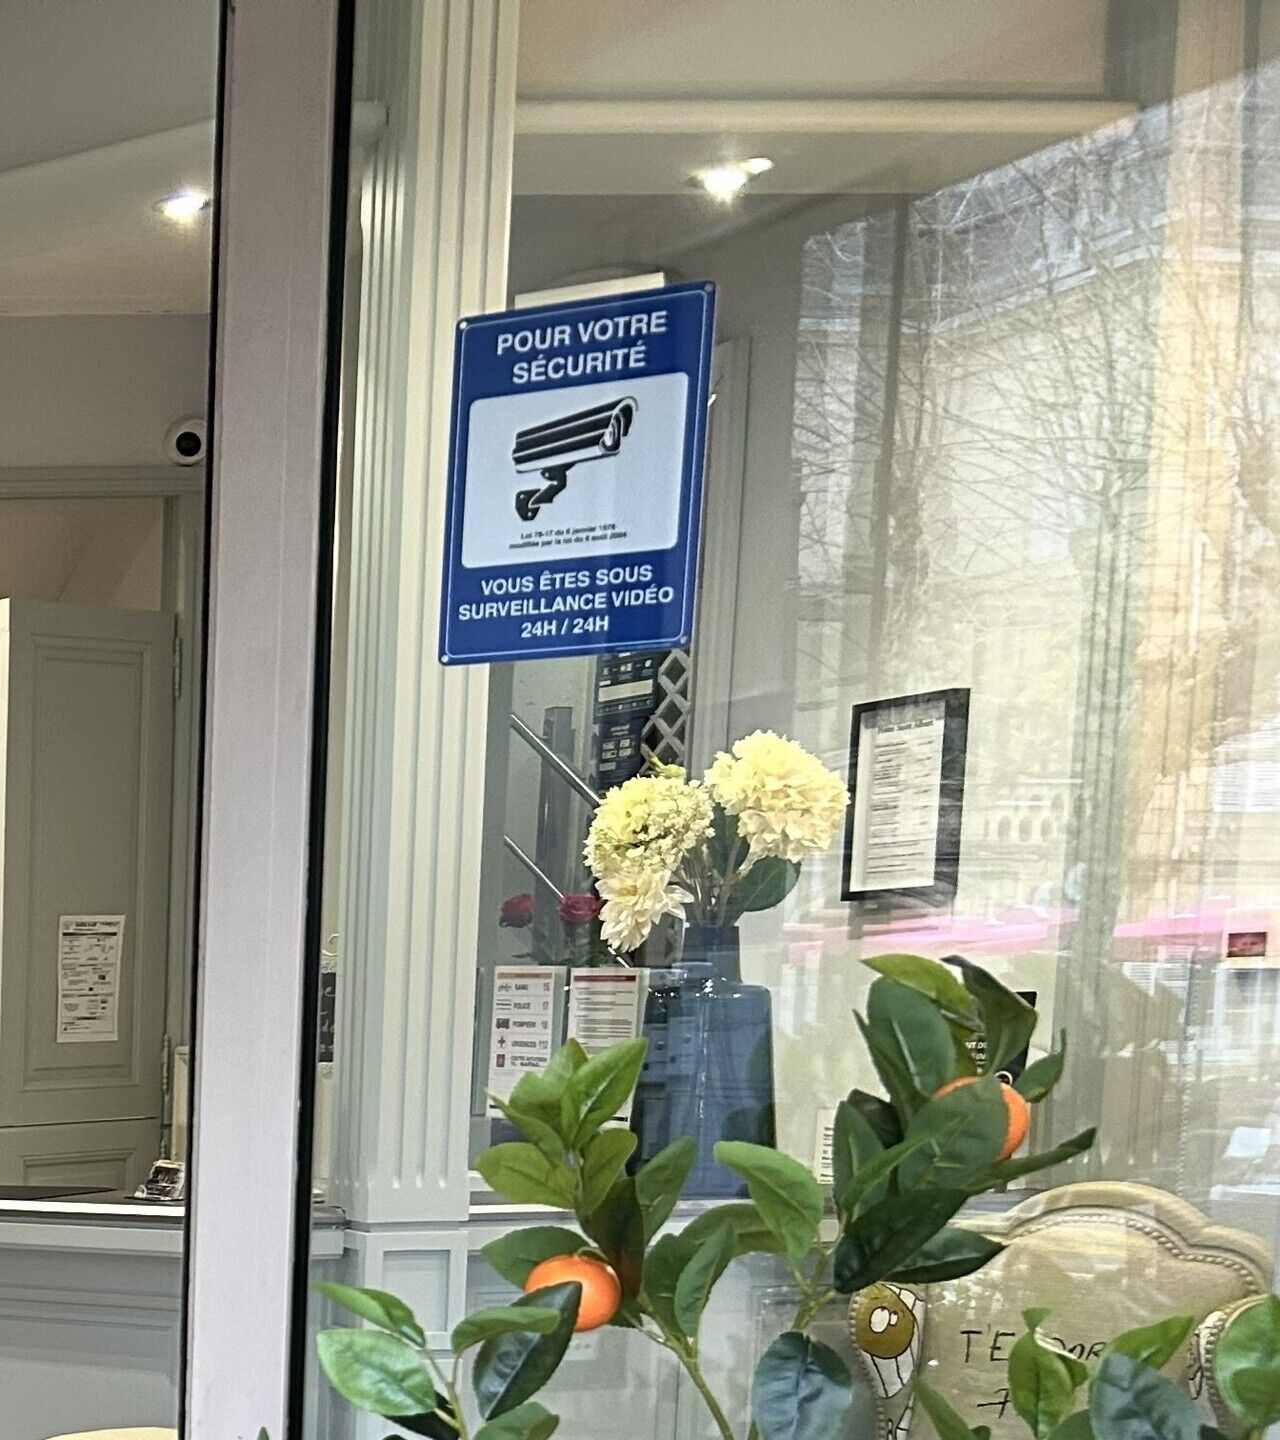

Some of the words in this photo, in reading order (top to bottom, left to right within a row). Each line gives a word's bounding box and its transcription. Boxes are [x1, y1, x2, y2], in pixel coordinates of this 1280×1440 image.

[497, 321, 575, 355] POUR
[578, 310, 668, 343] VOTRE
[512, 341, 647, 385] SÉCURITÉ
[481, 576, 534, 596] VOUS
[539, 570, 590, 592] ÊTES
[595, 564, 653, 585] SOUS
[458, 592, 607, 621] SURVEILLANCE
[611, 584, 674, 608] VIDÉO
[521, 618, 558, 638] 24H
[561, 618, 569, 635] /
[572, 614, 609, 635] 24H
